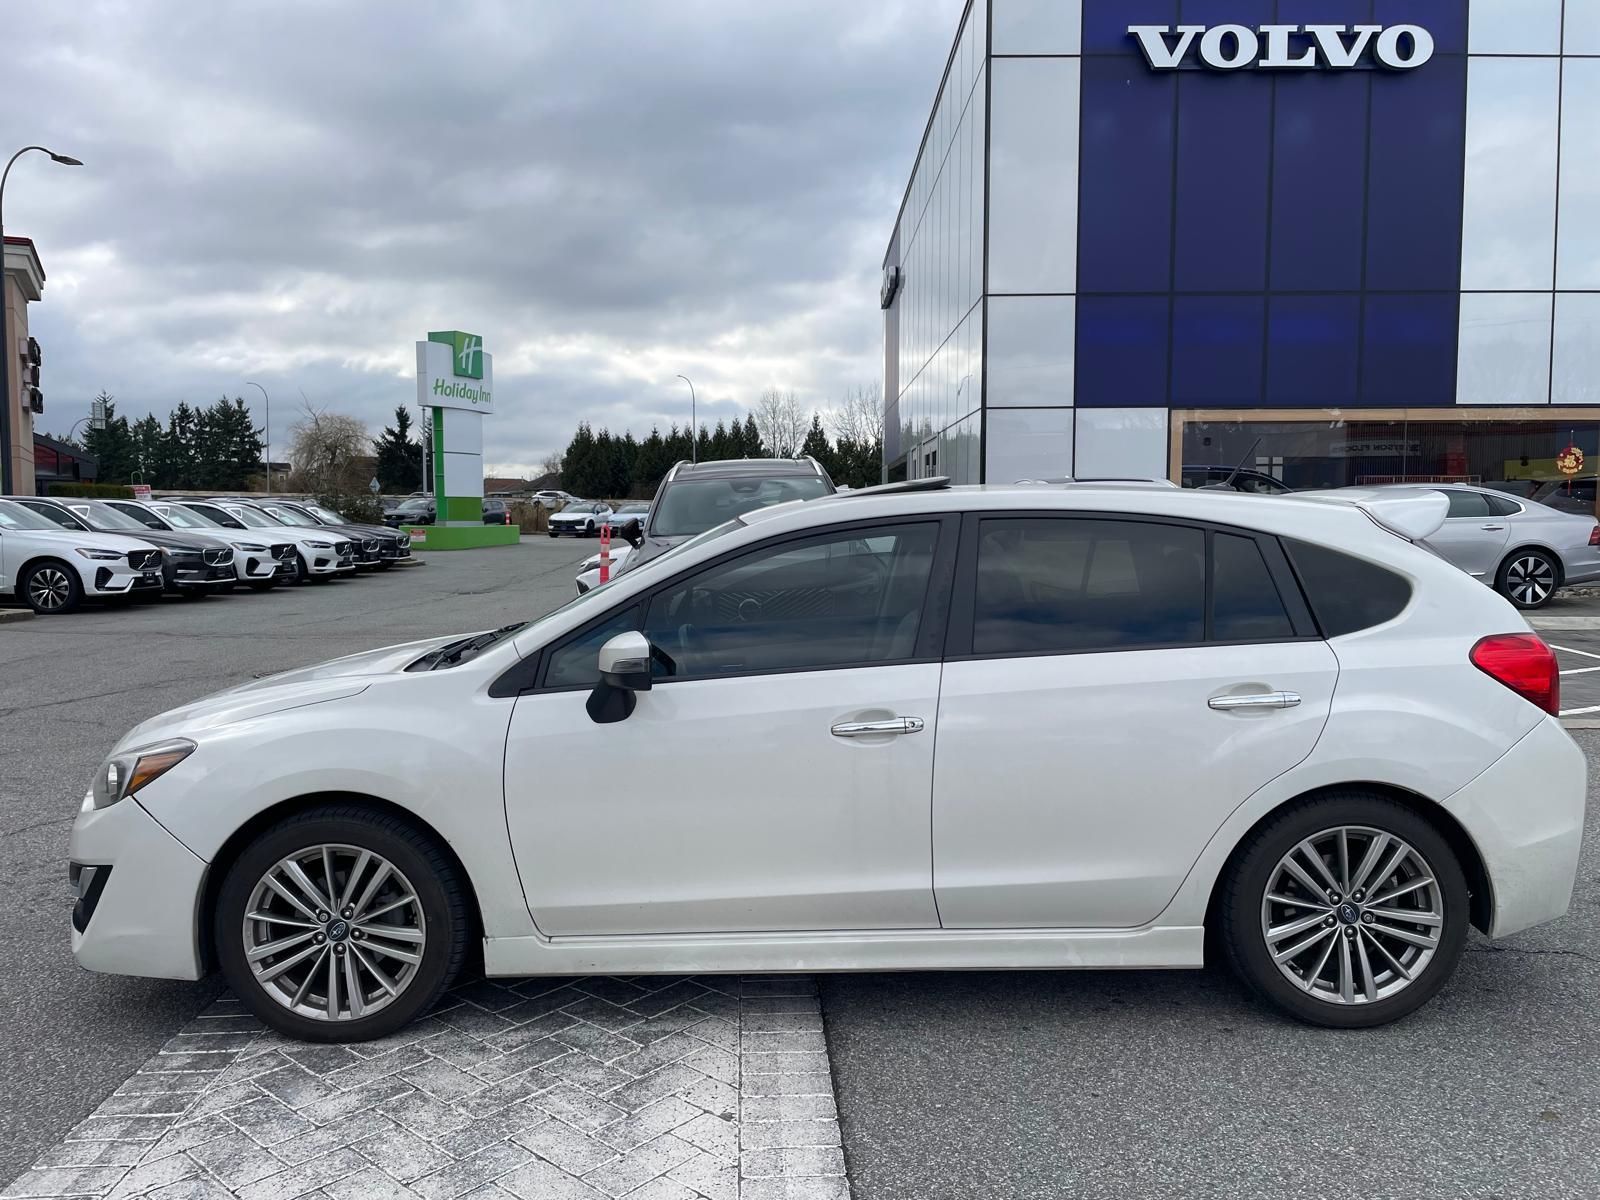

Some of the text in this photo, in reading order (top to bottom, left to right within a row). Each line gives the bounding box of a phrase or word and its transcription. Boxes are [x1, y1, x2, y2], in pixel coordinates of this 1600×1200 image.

[1127, 24, 1435, 70] VOLVO
[433, 378, 491, 404] Holiday Inn
